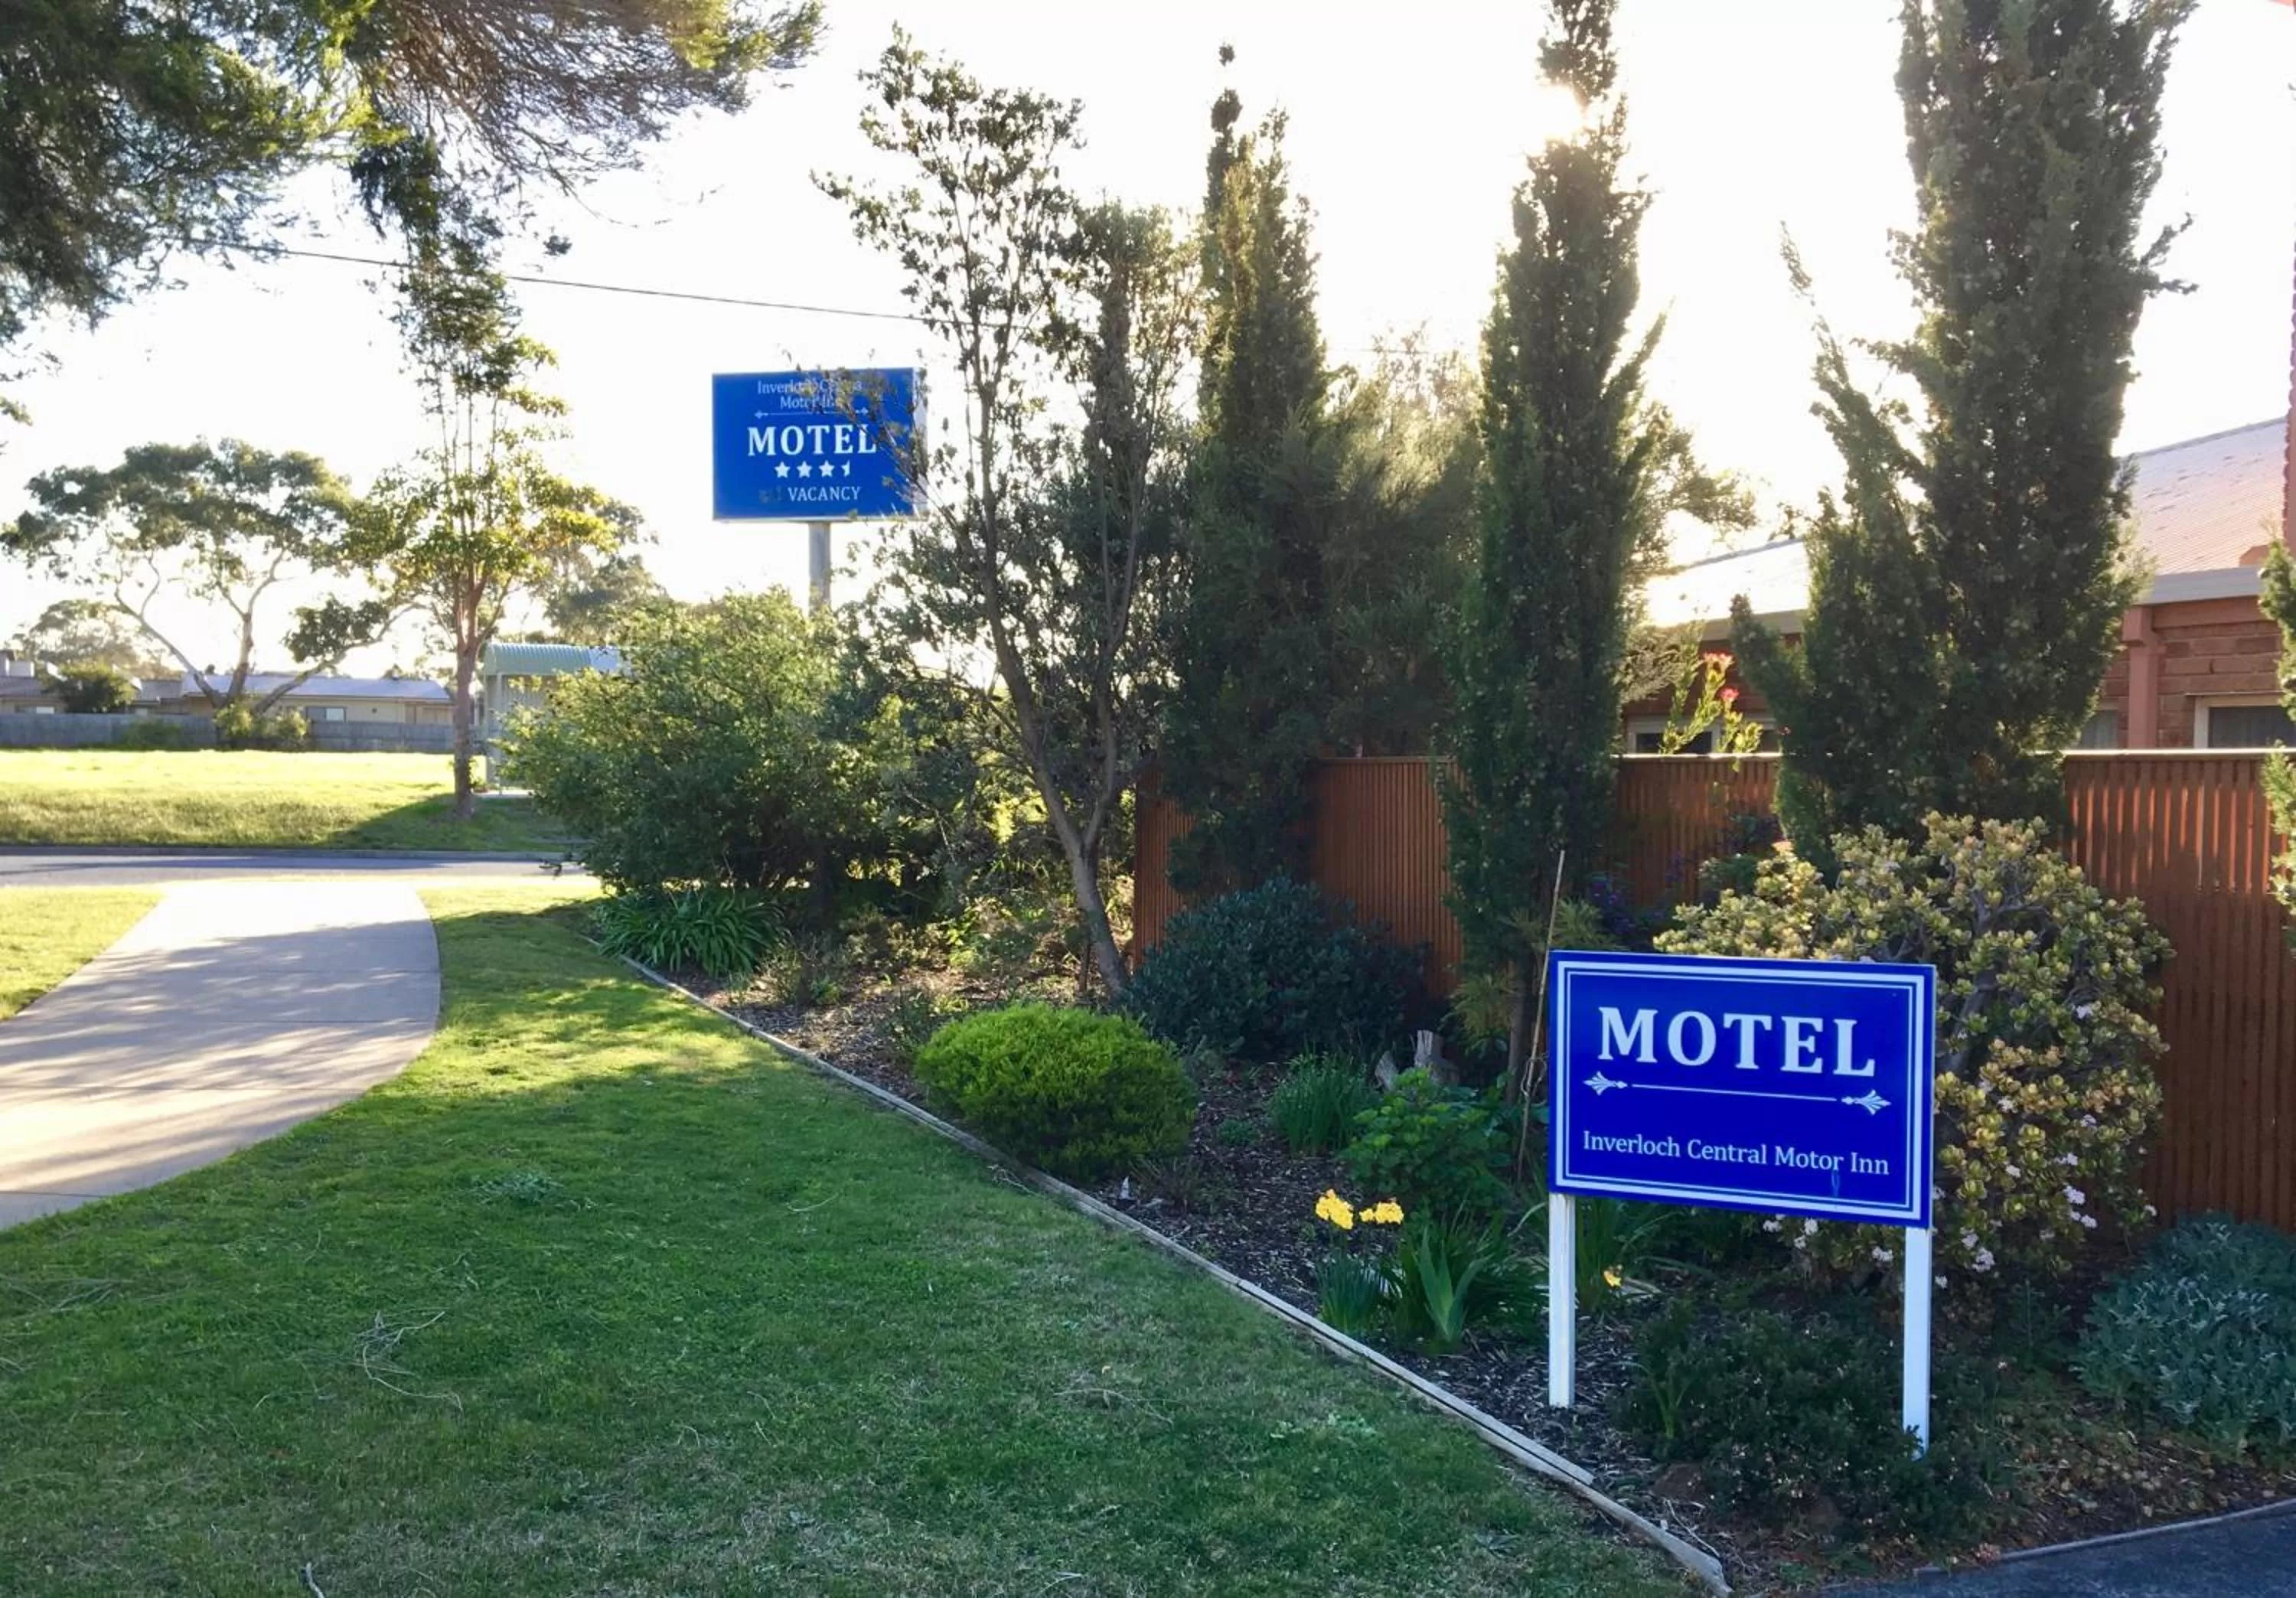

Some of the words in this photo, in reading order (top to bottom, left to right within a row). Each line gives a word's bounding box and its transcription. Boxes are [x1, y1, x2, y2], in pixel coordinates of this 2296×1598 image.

[758, 379, 817, 394] Inverlo
[748, 424, 876, 456] MOTEL
[788, 487, 862, 501] VACANCY
[1598, 1006, 1876, 1077] MOTEL
[1583, 1130, 1681, 1157] Inverloch
[1688, 1138, 1767, 1165] Central
[1775, 1145, 1844, 1170] Motor
[1851, 1151, 1890, 1176] Inn
